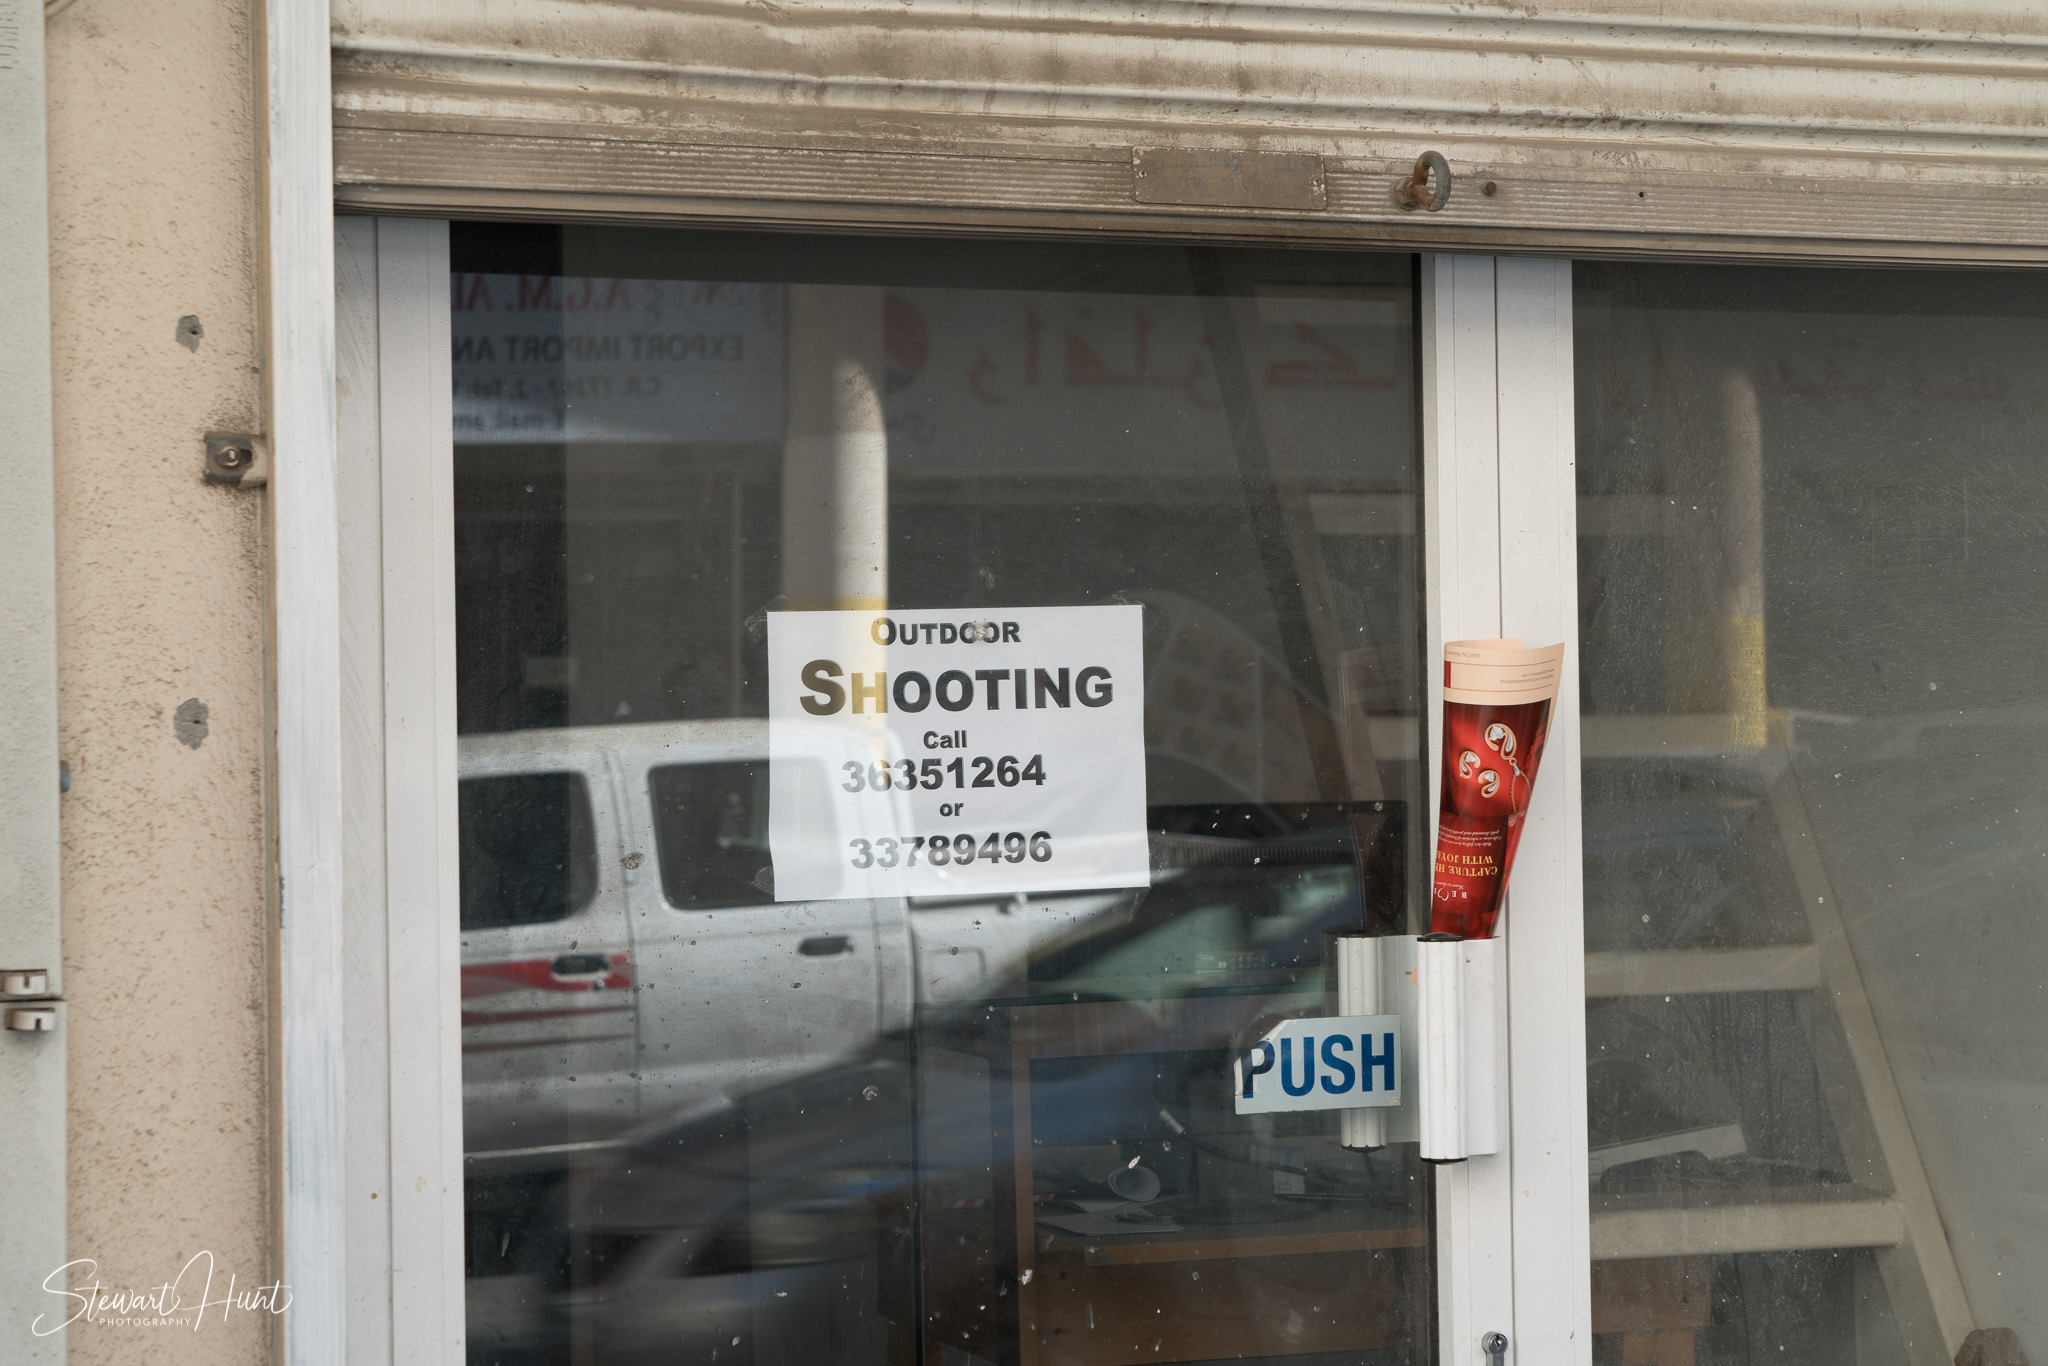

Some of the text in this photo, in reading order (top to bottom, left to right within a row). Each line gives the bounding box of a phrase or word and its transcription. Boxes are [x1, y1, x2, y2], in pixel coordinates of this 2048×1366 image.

[870, 616, 1022, 646] OUTDOOR
[799, 659, 1114, 716] SHOOTING
[923, 729, 968, 750] Call
[842, 753, 1047, 794] 36351264
[939, 800, 964, 817] or
[848, 831, 1053, 870] 33789496
[1462, 856, 1493, 864] WITH
[1449, 866, 1498, 876] CAPTURE
[1240, 1032, 1395, 1099] PUSH
